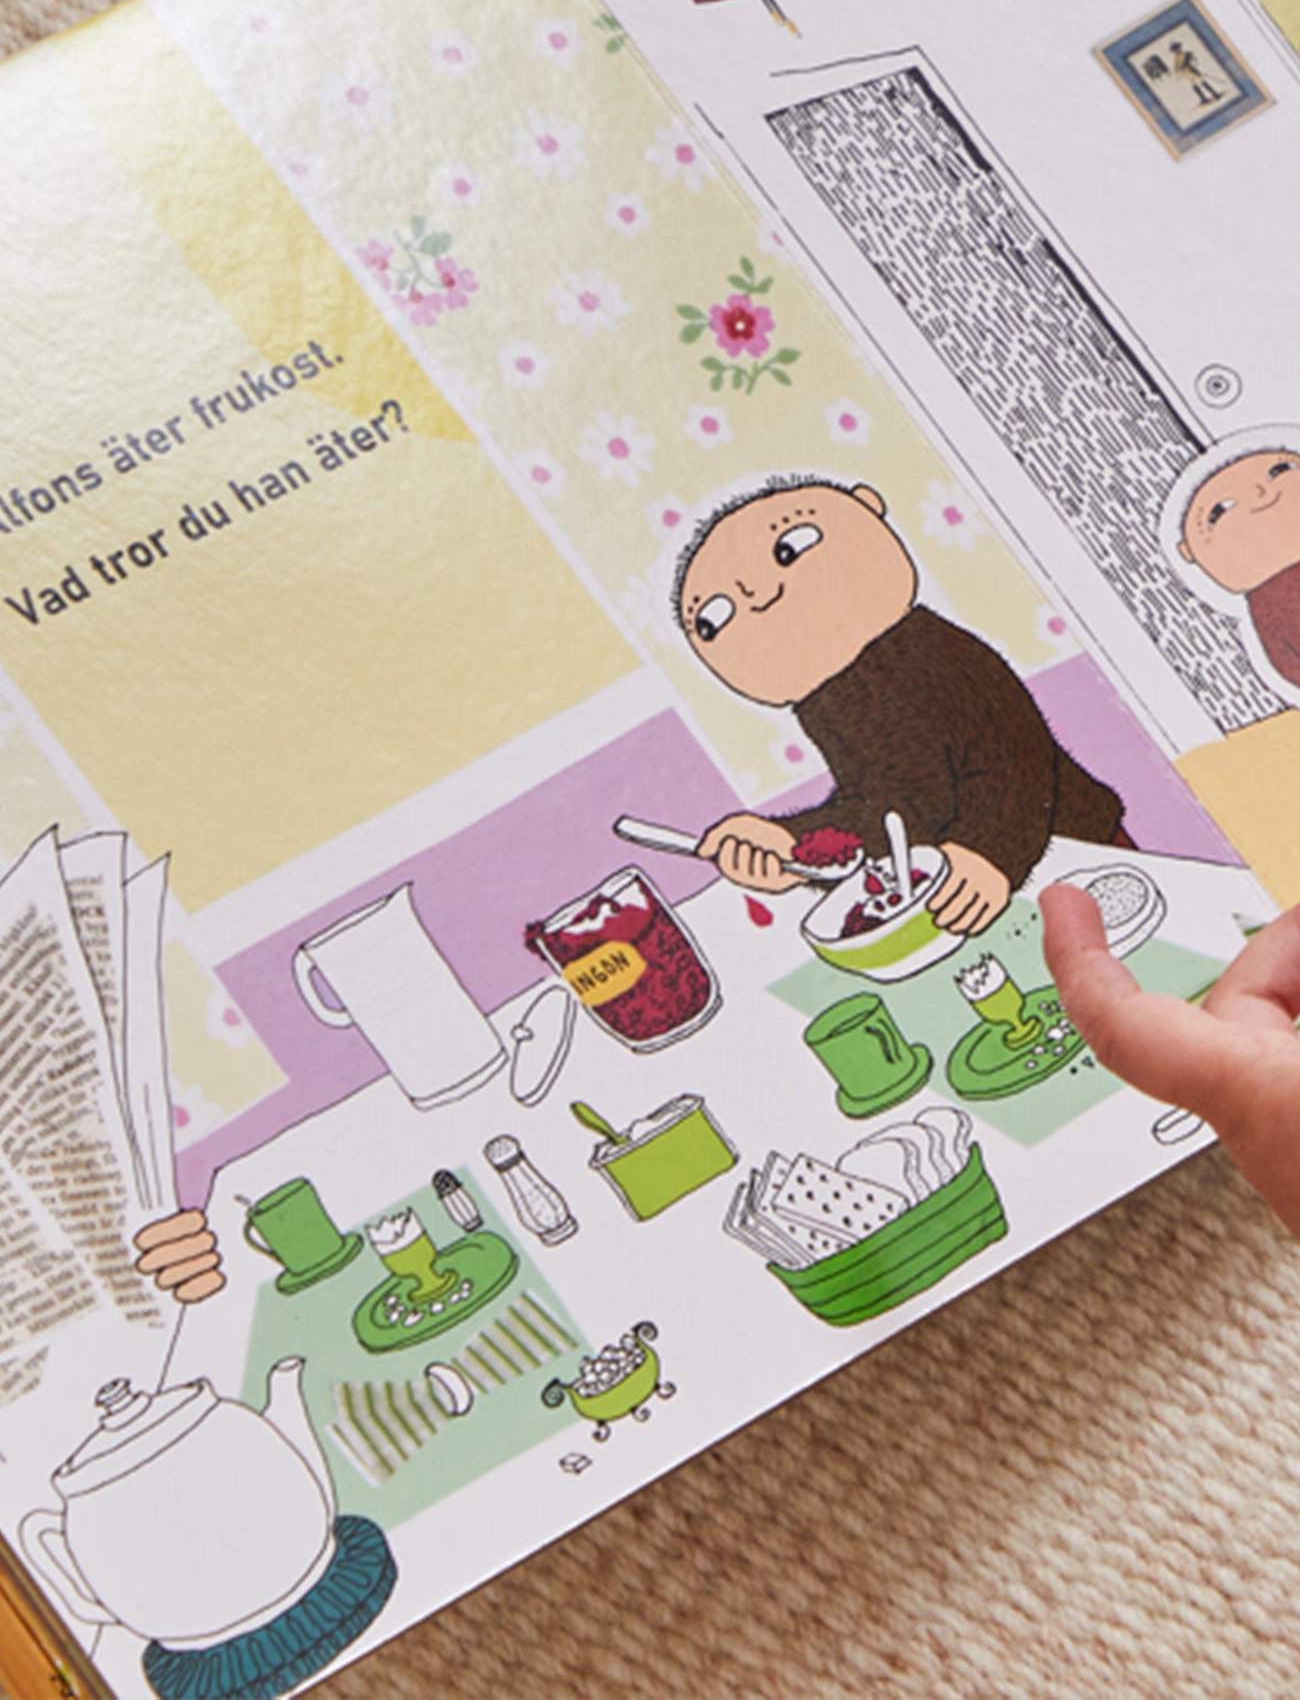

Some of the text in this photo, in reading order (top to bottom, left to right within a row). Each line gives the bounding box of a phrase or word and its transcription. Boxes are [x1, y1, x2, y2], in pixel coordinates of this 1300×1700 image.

[100, 415, 186, 475] äter
[189, 340, 344, 430] frukost.
[3, 399, 409, 626] Vad tror du han äter?
